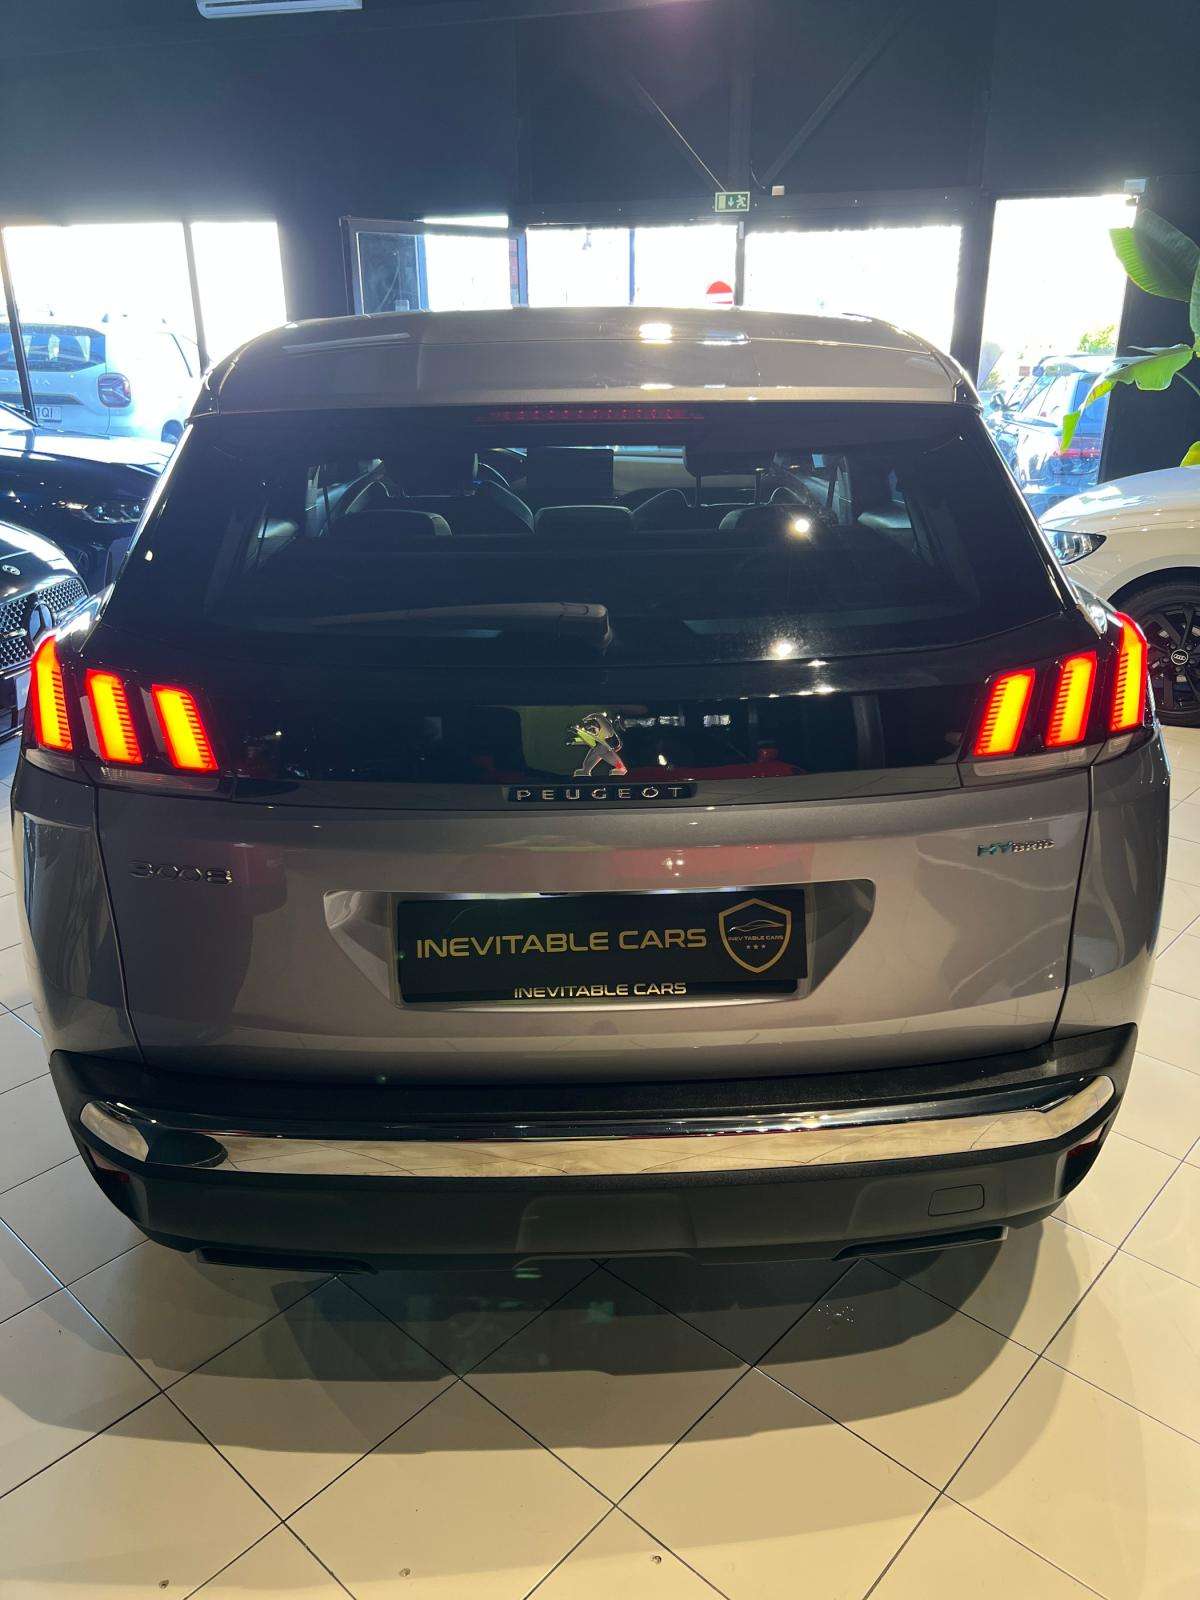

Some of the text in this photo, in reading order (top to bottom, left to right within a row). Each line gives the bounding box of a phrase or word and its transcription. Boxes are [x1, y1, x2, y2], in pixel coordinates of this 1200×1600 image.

[517, 787, 683, 801] PEUGEOT
[128, 860, 233, 886] 3008
[416, 928, 707, 959] INEVITABLE CARS
[514, 982, 687, 998] INEVITABLE CARS
